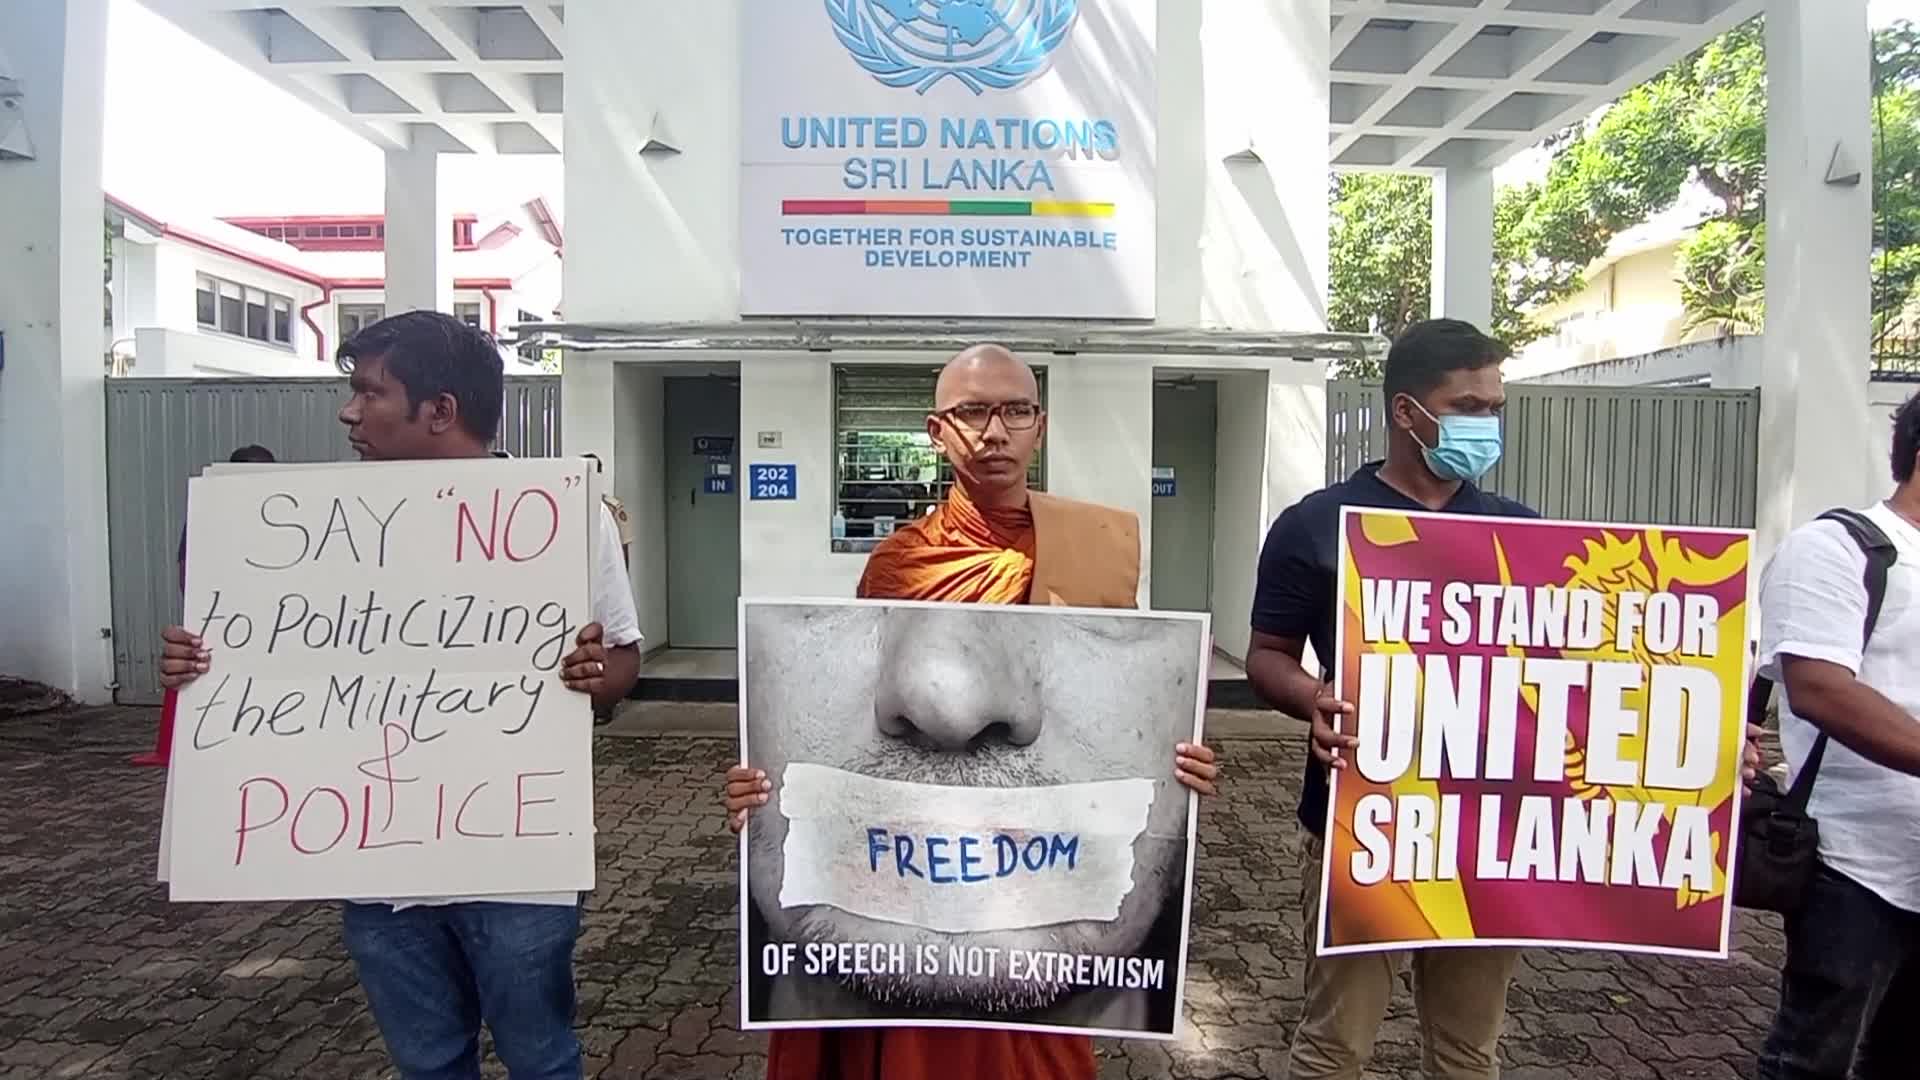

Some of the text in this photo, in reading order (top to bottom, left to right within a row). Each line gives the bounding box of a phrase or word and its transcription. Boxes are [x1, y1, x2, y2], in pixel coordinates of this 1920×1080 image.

[781, 117, 1119, 152] UNITED NATIONS
[843, 157, 1056, 192] SRI LANKA
[781, 228, 1117, 250] TOGETHER FOR SUSTAINABLE
[865, 250, 1032, 268] DEVELOPMENT
[711, 479, 726, 492] IN
[757, 468, 789, 480] 202
[758, 484, 789, 497] 204
[1152, 483, 1174, 494] OUT
[245, 493, 407, 569] SAY
[202, 590, 252, 649] to
[1361, 578, 1719, 657] WE STAND FOR
[193, 668, 544, 750] the Military
[1356, 653, 1721, 790] UNITED
[235, 770, 574, 866] POLICE.
[867, 828, 1080, 884] FREEDOM
[1351, 794, 1714, 892] SRI LANKA
[763, 943, 1164, 990] OF SPEECH IS NOT EXTREMISM
